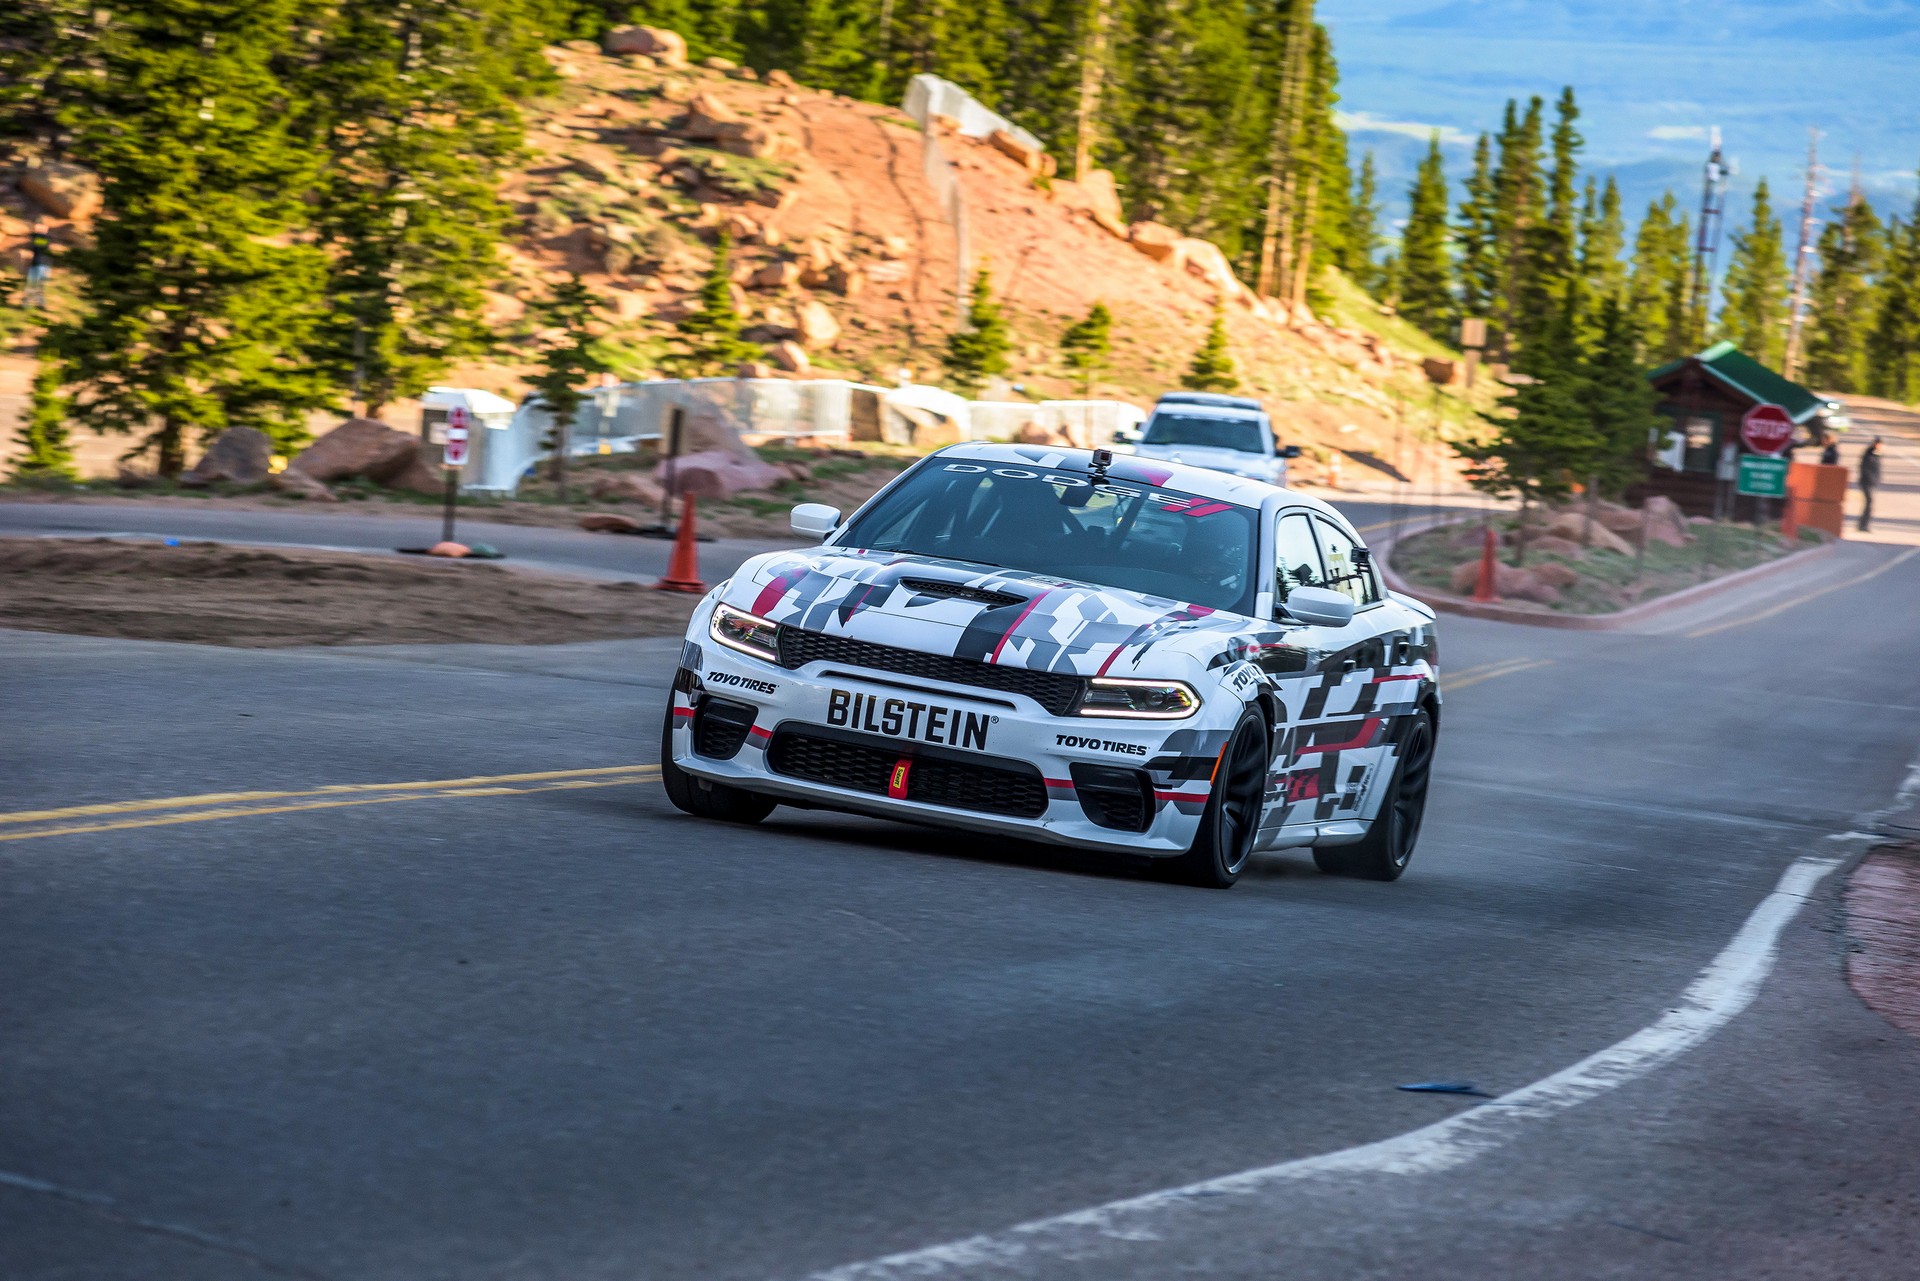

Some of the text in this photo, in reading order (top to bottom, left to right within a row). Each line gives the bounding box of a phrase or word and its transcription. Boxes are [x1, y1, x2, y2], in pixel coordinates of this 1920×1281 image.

[943, 464, 1191, 509] DODGE
[707, 671, 777, 695] TOYO TIRES
[1056, 734, 1148, 756] TOYO TIRES
